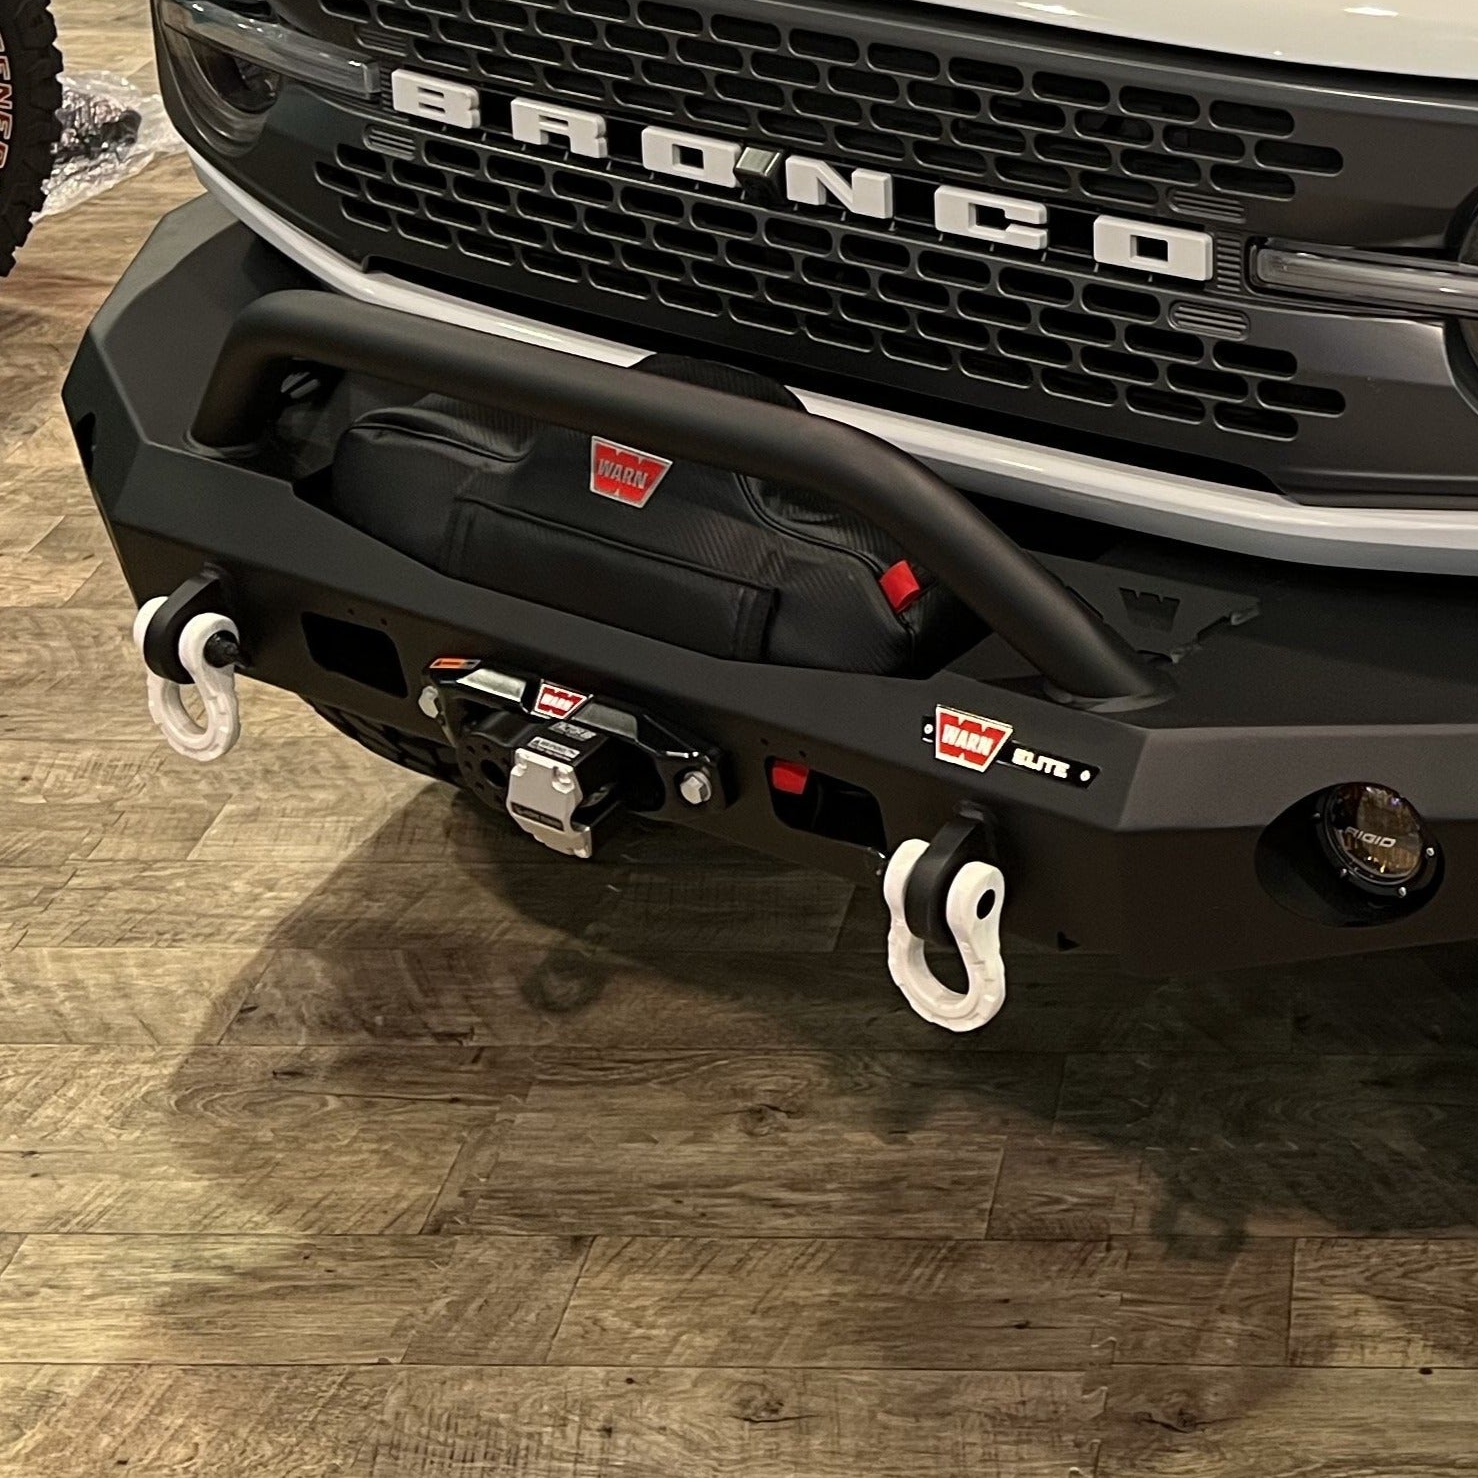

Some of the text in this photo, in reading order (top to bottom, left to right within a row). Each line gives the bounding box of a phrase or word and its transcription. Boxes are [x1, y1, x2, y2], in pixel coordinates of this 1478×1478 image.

[391, 69, 1212, 281] BRONCO
[598, 458, 649, 490] WARN
[941, 724, 1071, 779] WARN ELITE
[1344, 826, 1397, 848] RIGID
